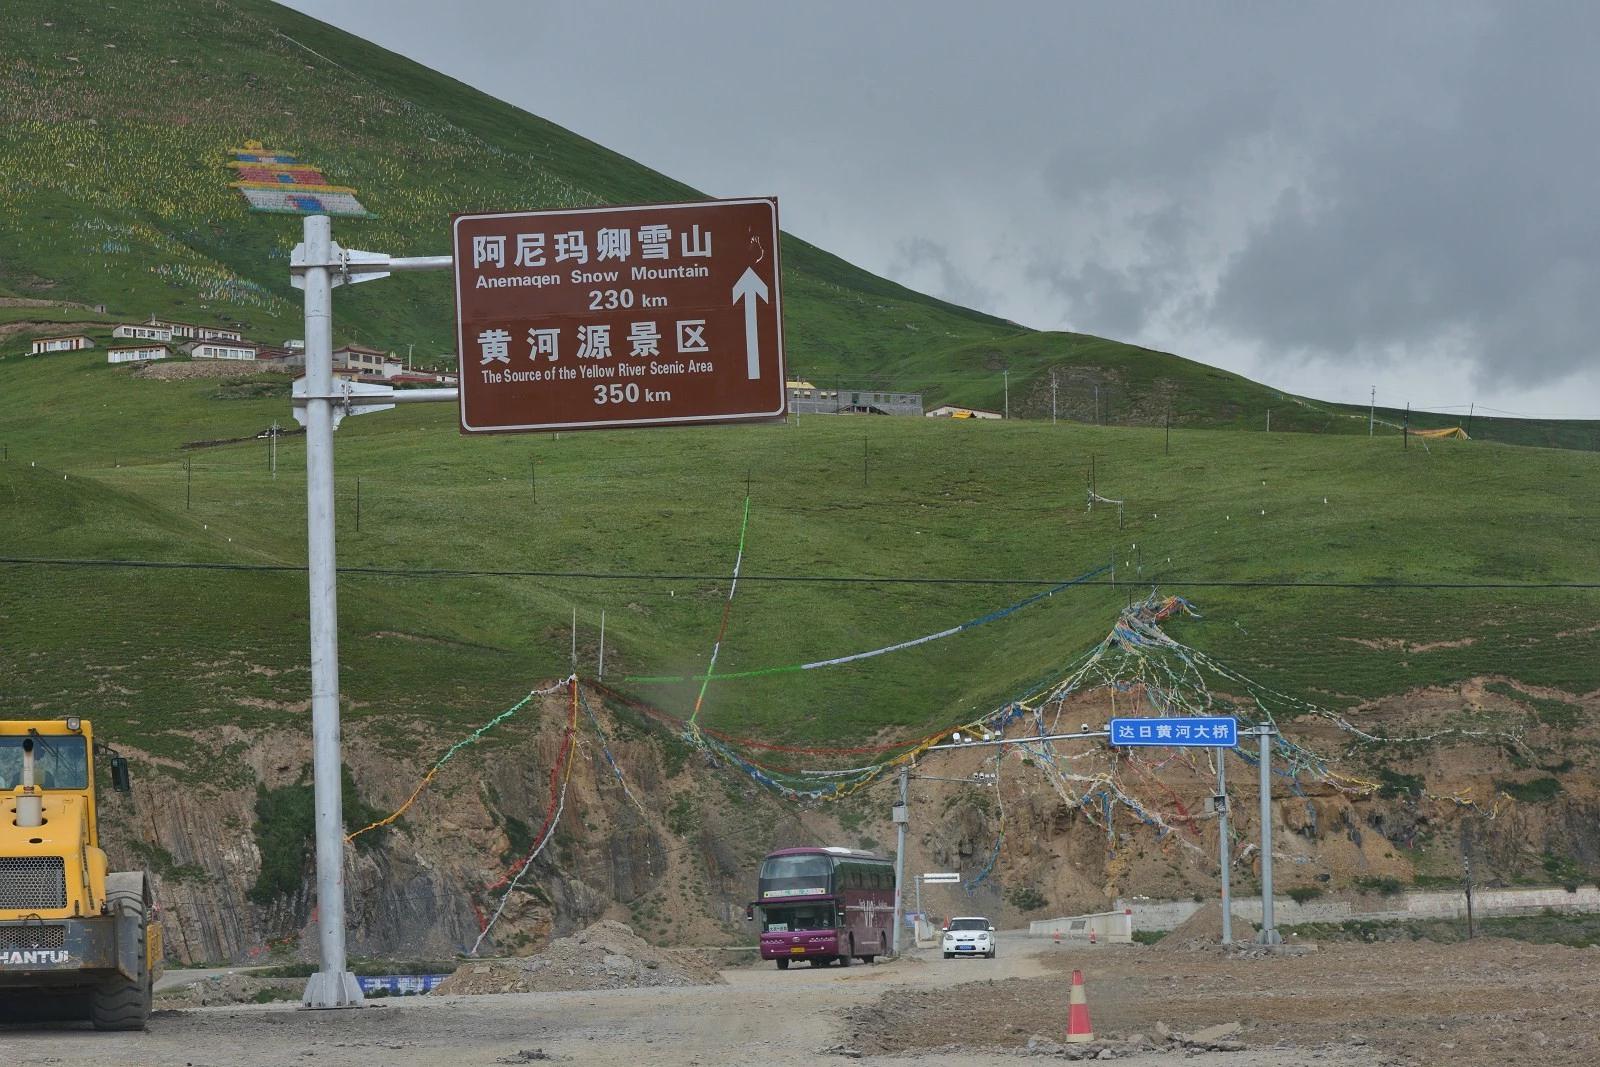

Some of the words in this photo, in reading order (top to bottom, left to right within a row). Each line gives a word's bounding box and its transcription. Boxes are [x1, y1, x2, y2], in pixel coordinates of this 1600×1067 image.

[472, 223, 712, 269] 阿尼玛卿雪山
[475, 274, 561, 289] Anemaqen
[571, 269, 619, 284] Snow
[631, 263, 709, 281] Mountain
[588, 288, 634, 311] 230
[642, 293, 668, 308] km
[477, 319, 710, 365] 黄河源景区
[481, 369, 502, 384] The
[503, 368, 542, 383] Source
[544, 366, 556, 381] of
[559, 366, 577, 380] the
[579, 364, 615, 379] Yellow
[618, 362, 646, 377] River
[650, 360, 685, 375] Scenic
[687, 359, 713, 373] Area
[593, 382, 640, 405] 350
[645, 388, 671, 402] km
[1119, 724, 1229, 739] 达日黄河大桥
